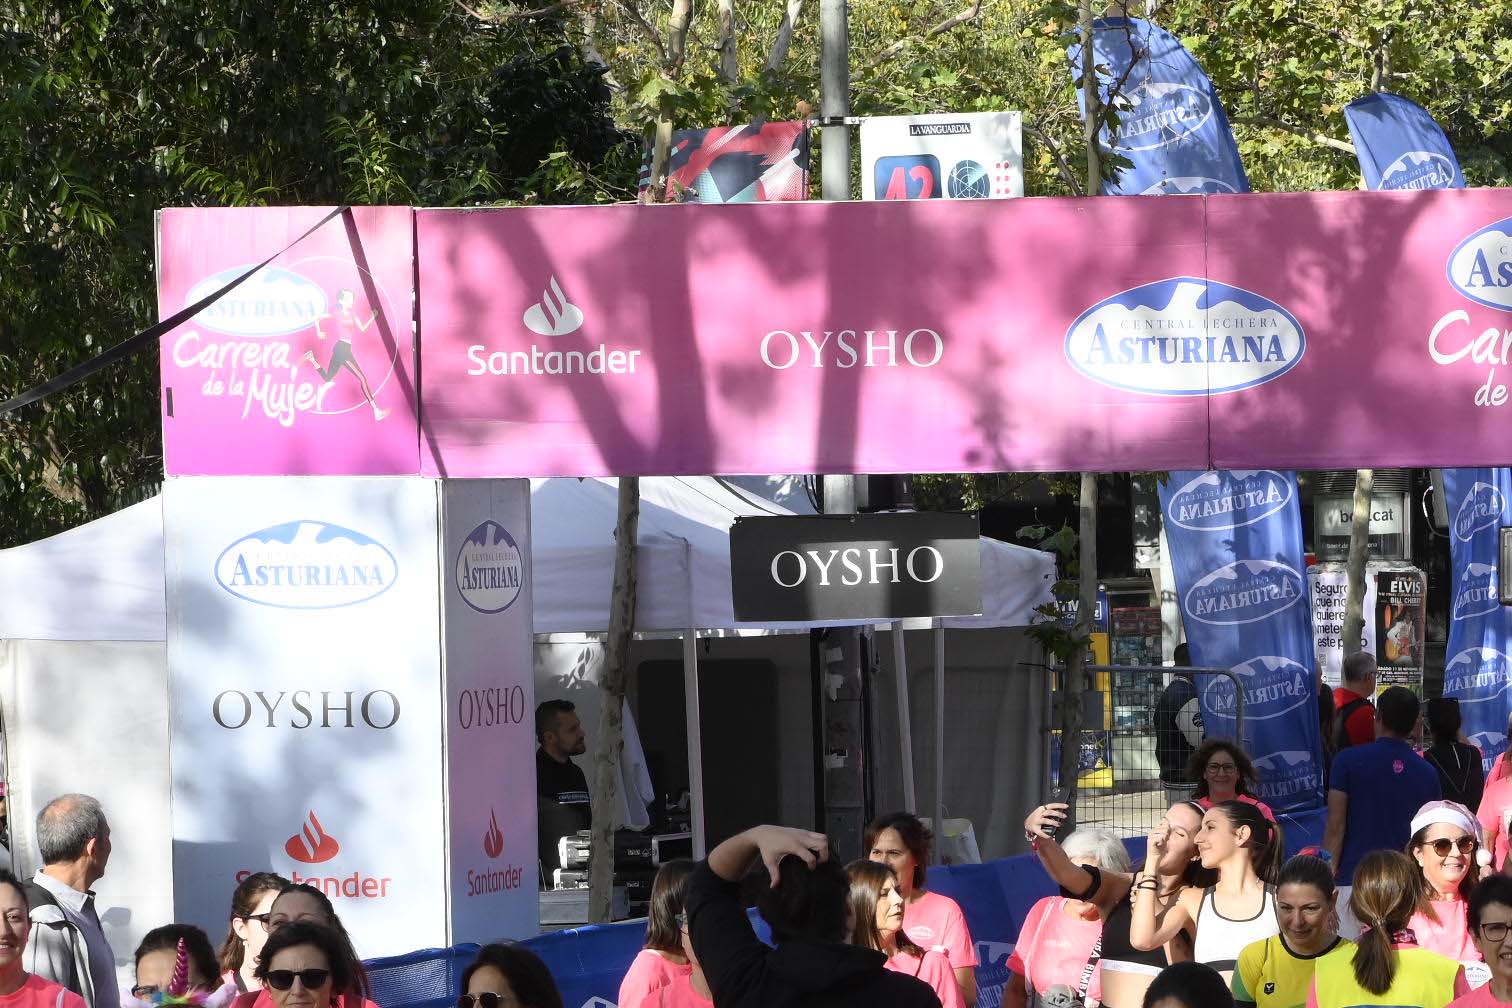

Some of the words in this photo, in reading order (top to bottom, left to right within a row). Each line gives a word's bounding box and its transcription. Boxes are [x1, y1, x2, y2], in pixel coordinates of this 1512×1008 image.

[921, 124, 970, 135] VANGUARDIA
[172, 330, 292, 368] Carrera
[467, 343, 641, 376] Santander
[760, 327, 944, 370] OYSHO
[1085, 322, 1287, 365] ASTURIANA
[203, 371, 224, 396] de
[228, 371, 244, 396] la
[241, 367, 335, 427] Mujer
[1474, 368, 1508, 407] de
[230, 553, 385, 588] ASTURIANA
[461, 555, 520, 591] ASTURIANA
[770, 546, 944, 589] OYSHO
[1390, 581, 1421, 593] ELVIS
[1317, 637, 1336, 648] este
[212, 688, 401, 730] OYSHO
[458, 685, 525, 729] OYSHO
[467, 864, 523, 897] Santander
[1079, 963, 1095, 998] BIMBA
